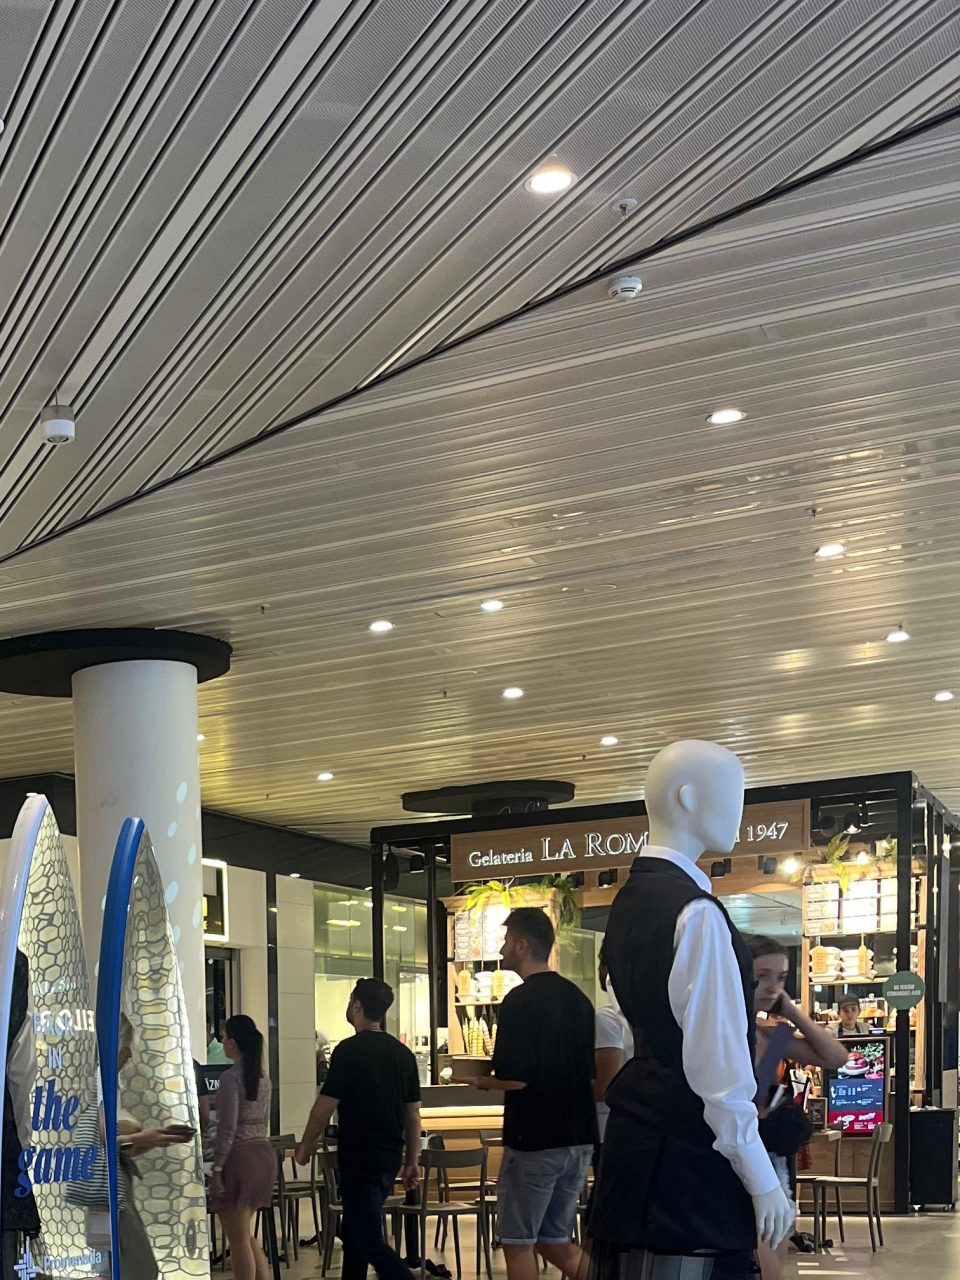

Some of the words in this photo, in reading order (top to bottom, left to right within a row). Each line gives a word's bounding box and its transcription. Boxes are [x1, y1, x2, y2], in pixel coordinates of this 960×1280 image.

[468, 847, 534, 868] Gelateria
[541, 836, 576, 862] LA
[747, 821, 789, 843] 1947
[48, 1047, 65, 1070] IN
[30, 1078, 80, 1131] the
[14, 1144, 100, 1198] game
